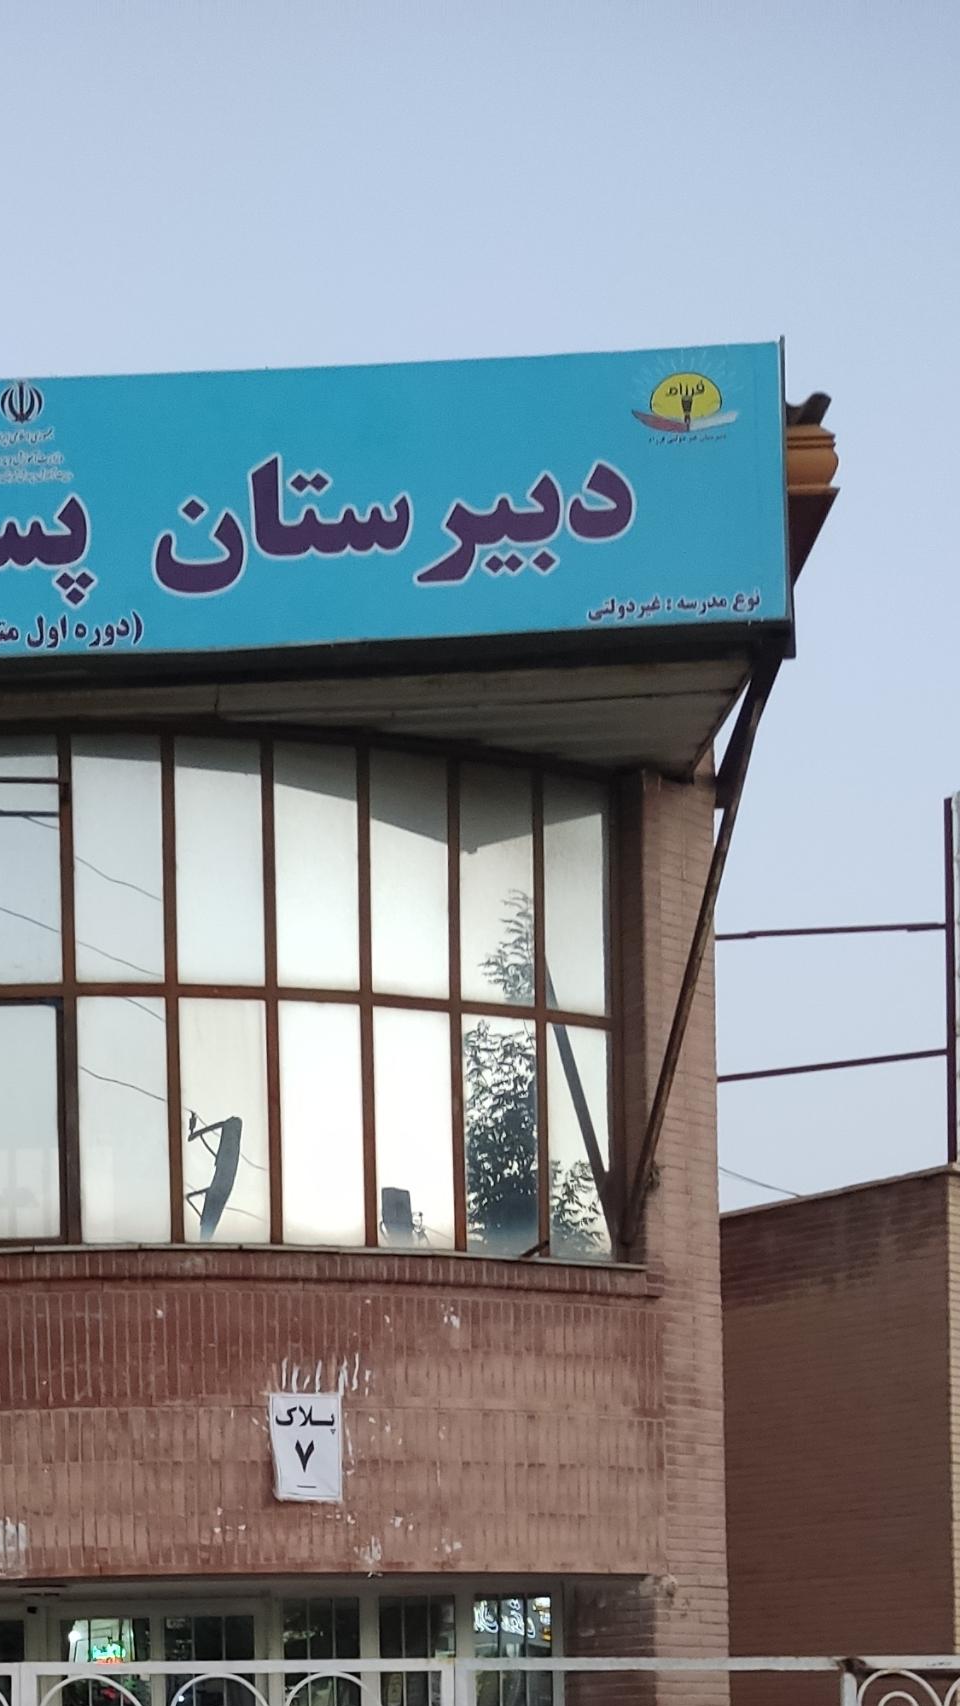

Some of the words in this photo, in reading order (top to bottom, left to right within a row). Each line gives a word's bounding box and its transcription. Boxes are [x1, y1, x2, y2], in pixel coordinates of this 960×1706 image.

[154, 457, 634, 592] دبیرستان
[677, 595, 727, 614] مدرسه
[732, 589, 761, 613] نوع
[27, 615, 67, 648] اول
[74, 611, 143, 647] (دوره
[275, 1405, 335, 1435] پلاک
[295, 1440, 315, 1472] ۷
